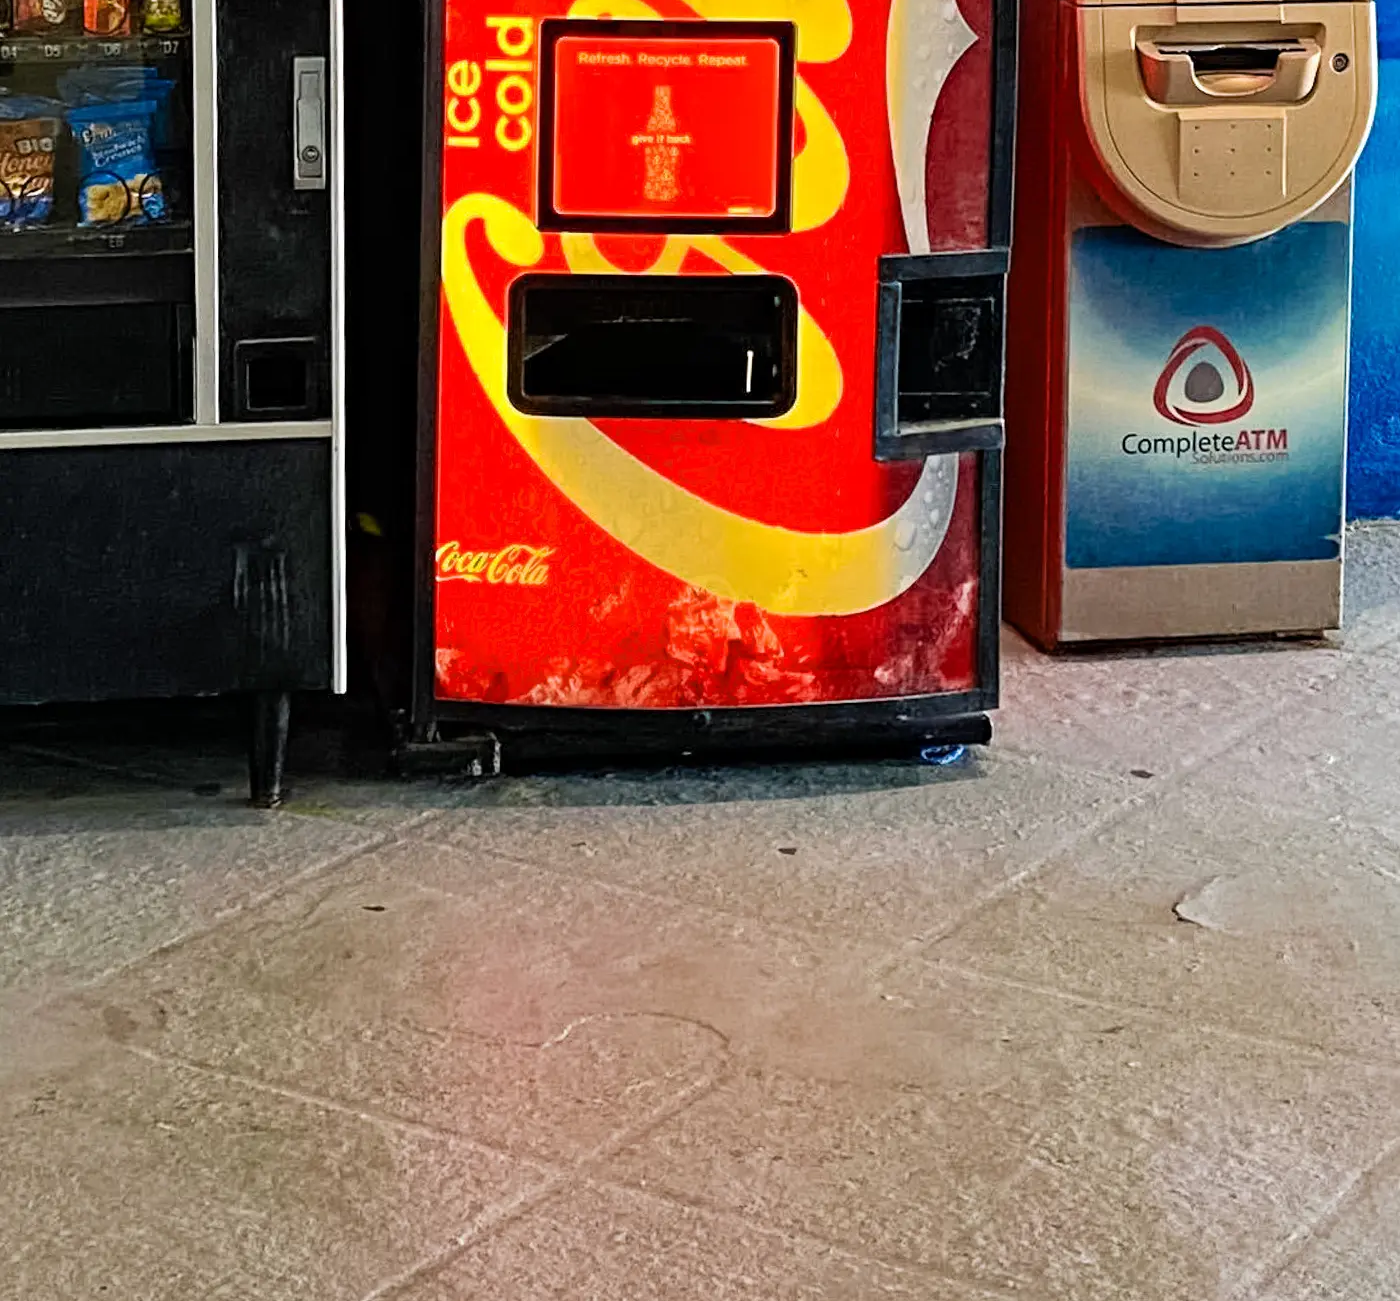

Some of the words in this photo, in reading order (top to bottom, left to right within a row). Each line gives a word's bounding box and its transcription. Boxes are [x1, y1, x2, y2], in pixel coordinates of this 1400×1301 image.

[44, 45, 62, 58] D5
[162, 41, 179, 55] D7
[485, 16, 535, 152] cold
[16, 137, 54, 153] BIG
[631, 134, 653, 145] give
[656, 134, 664, 144] it
[1121, 428, 1289, 459] CompleteATM
[1191, 450, 1290, 465] Solutions.com
[436, 541, 557, 586] Coca-Cola
